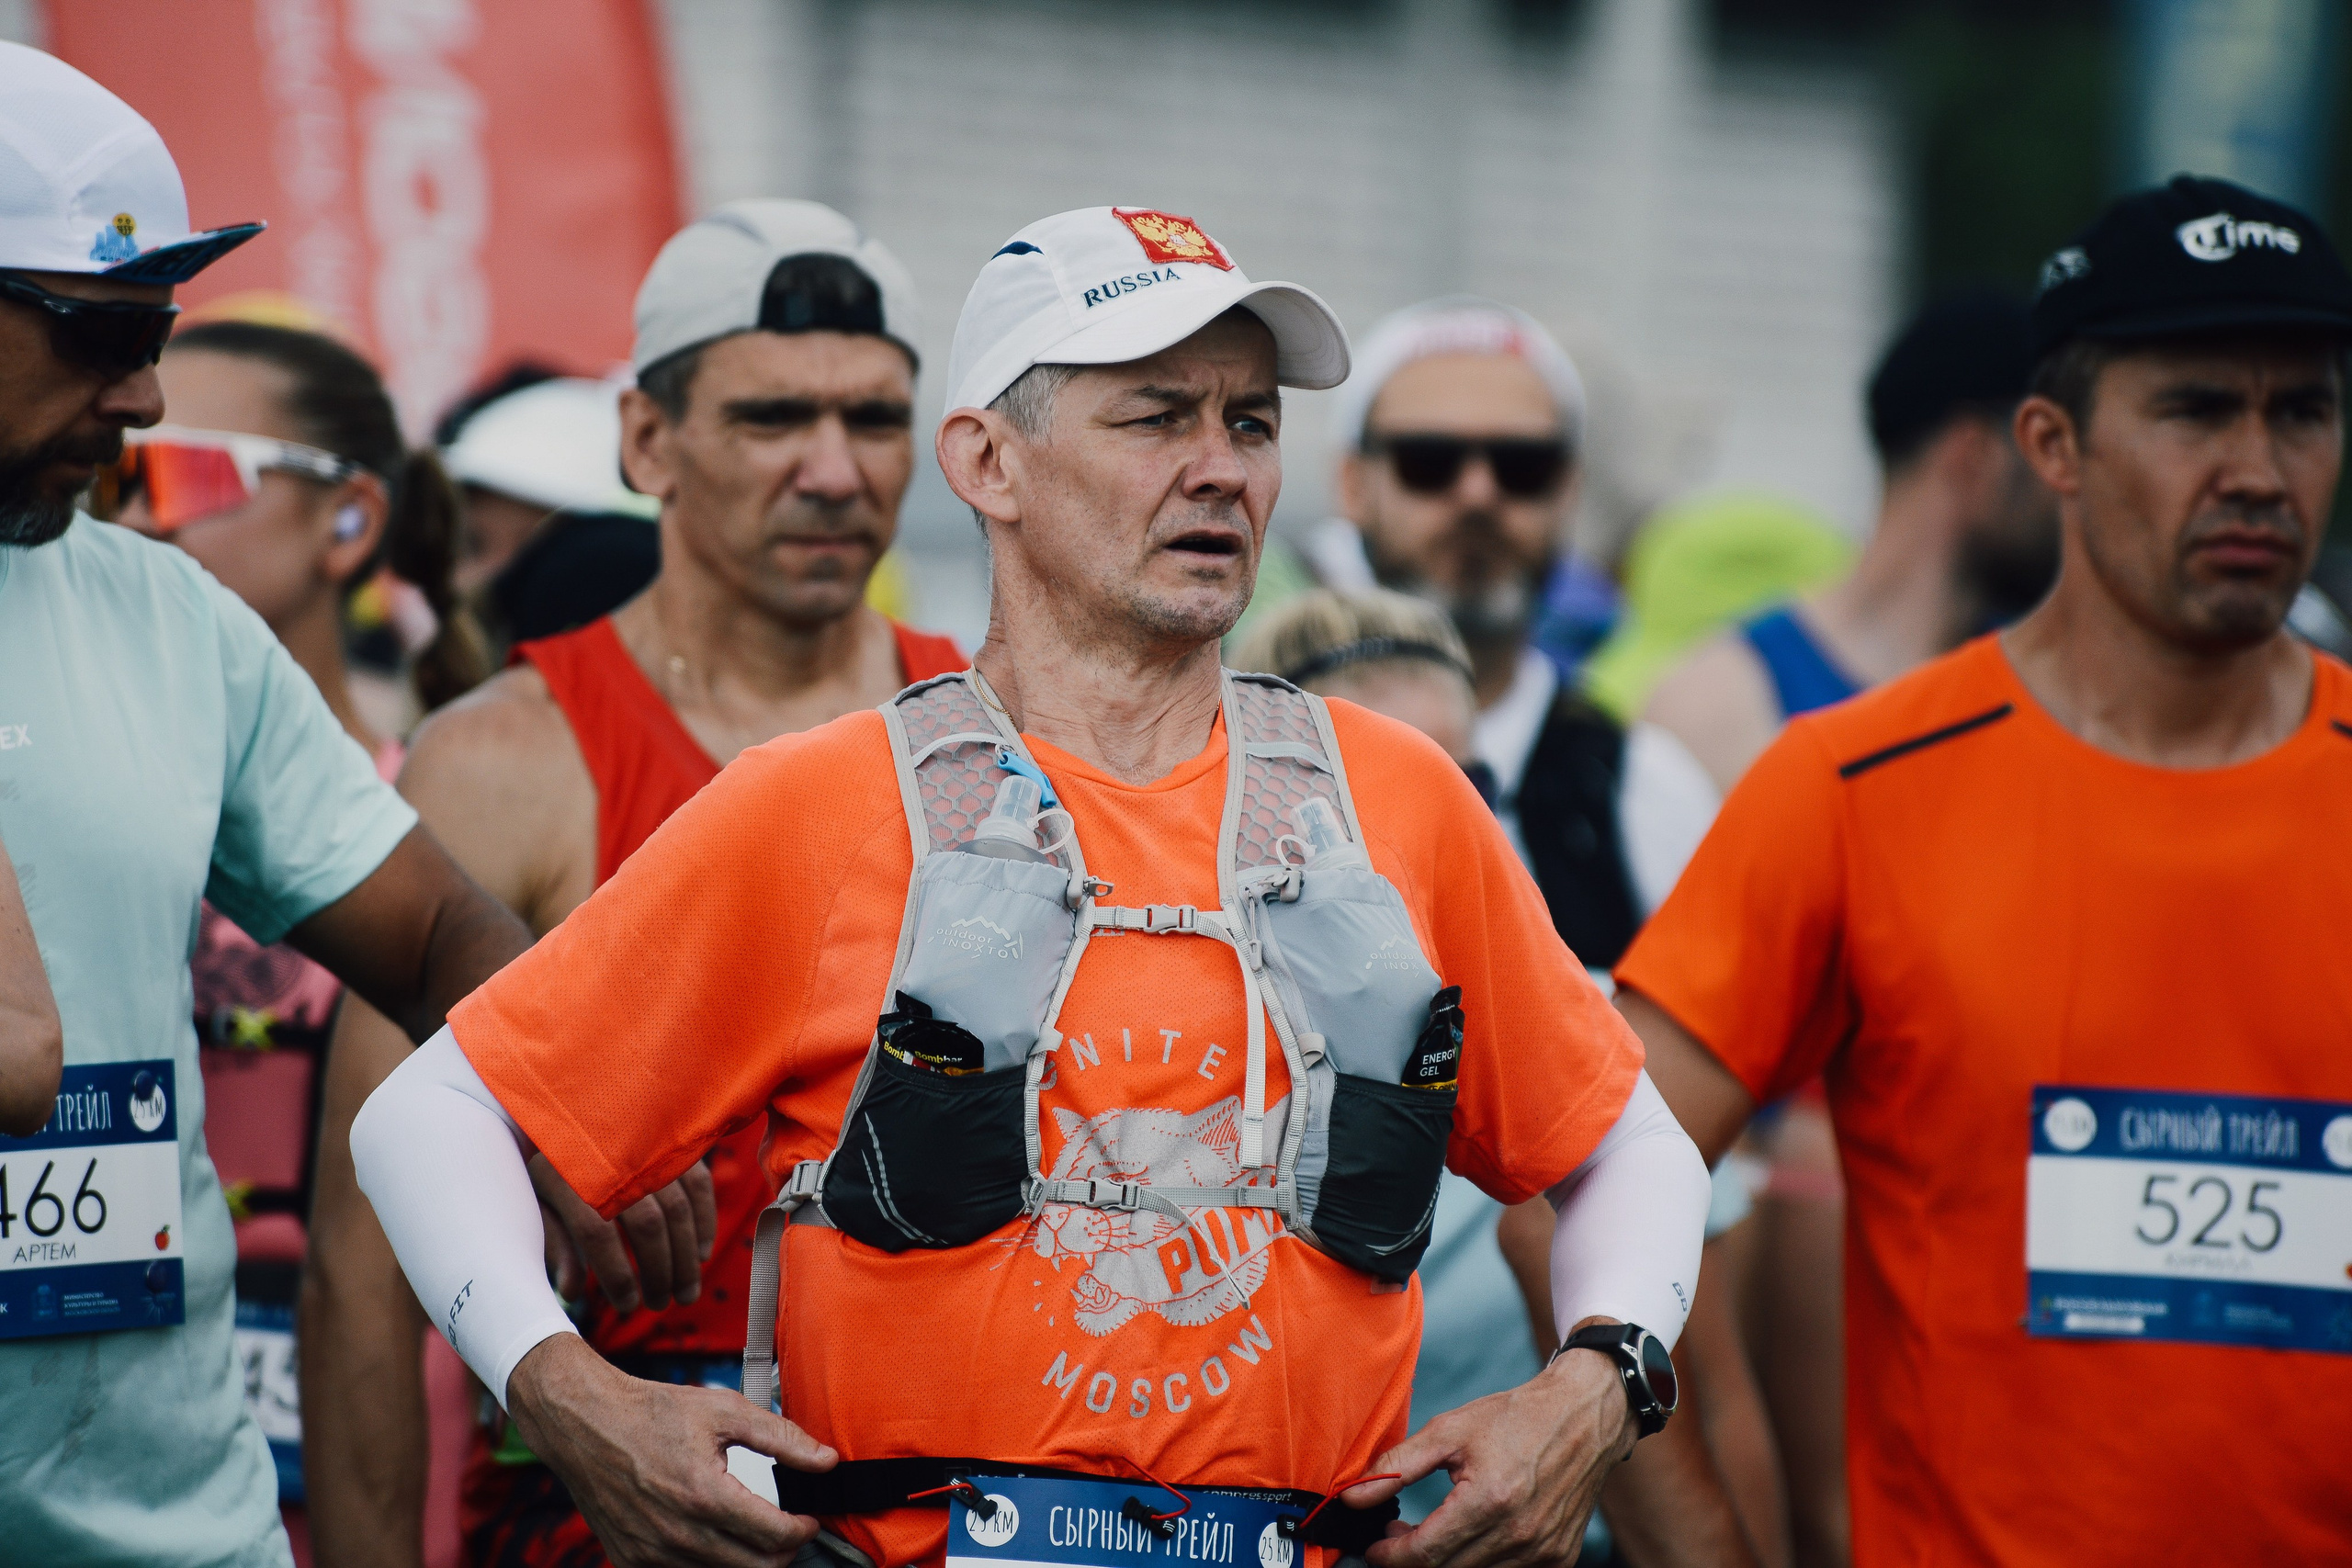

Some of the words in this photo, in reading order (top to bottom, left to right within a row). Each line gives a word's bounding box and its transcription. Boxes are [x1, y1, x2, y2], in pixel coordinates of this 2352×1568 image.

[1081, 266, 1182, 310] RUSSIA
[936, 928, 993, 944] outdoor
[1419, 1066, 1440, 1077] GEL
[1422, 1047, 1457, 1066] ENERGY
[55, 1084, 112, 1132] ТРЕЙЛ
[2135, 1174, 2284, 1254] 525
[13, 1243, 77, 1264] АРТЕМ
[1157, 1196, 1284, 1295] PUM
[1041, 1314, 1272, 1418] MOSCOW
[1261, 1536, 1273, 1562] 25
